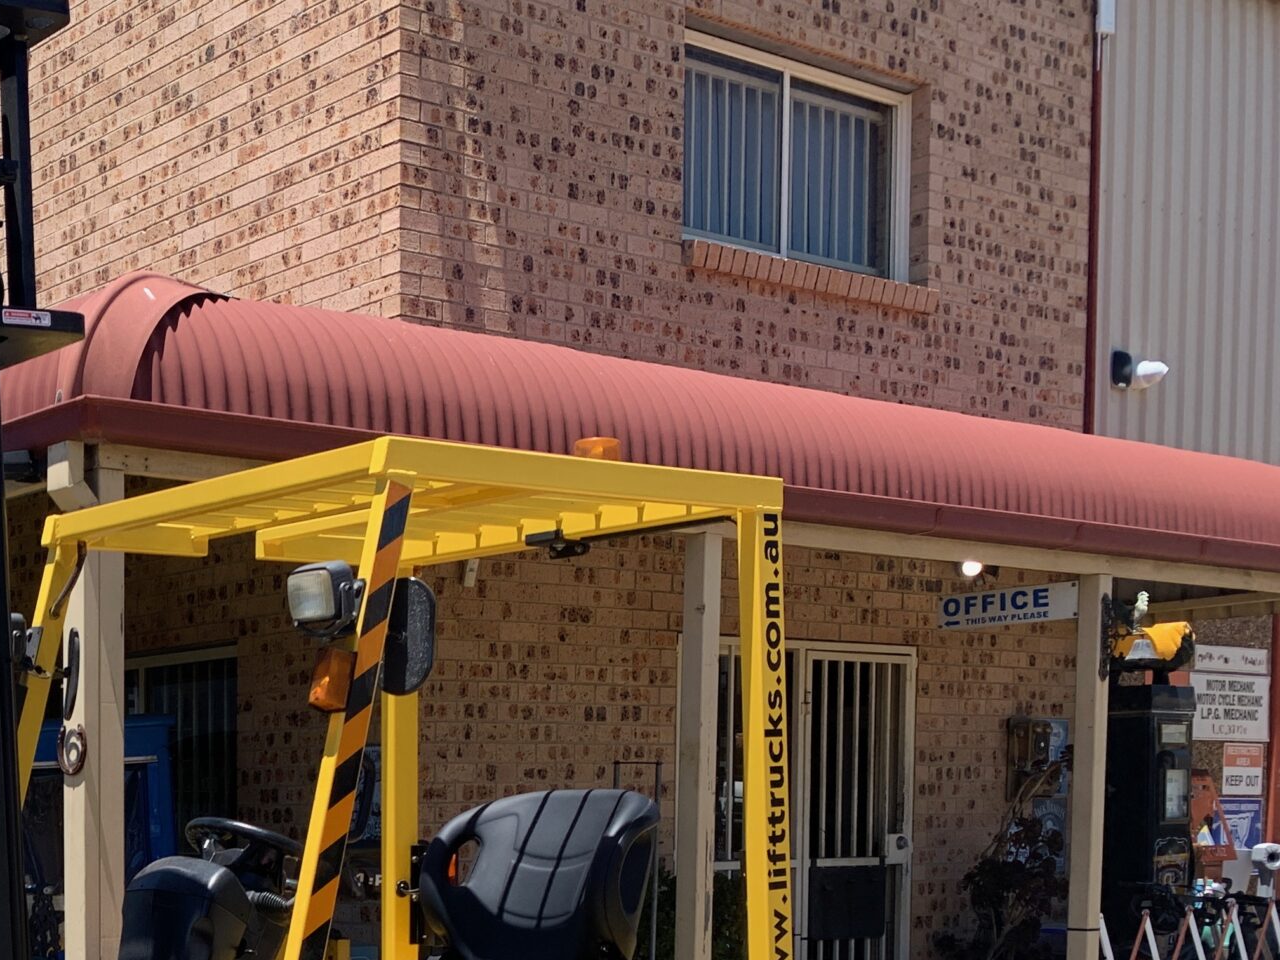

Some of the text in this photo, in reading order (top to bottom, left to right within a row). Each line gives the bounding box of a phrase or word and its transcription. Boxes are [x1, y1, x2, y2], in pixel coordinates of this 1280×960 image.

[943, 588, 1049, 617] OFFICE
[965, 611, 1049, 625] THIS WAY PLEASE
[1206, 679, 1256, 693] MOTOR MECHANIC
[1197, 693, 1263, 708] MOTOR CYCLE MECHANIC
[1223, 709, 1259, 721] MECHANIC
[1225, 775, 1260, 787] KEEP OUT
